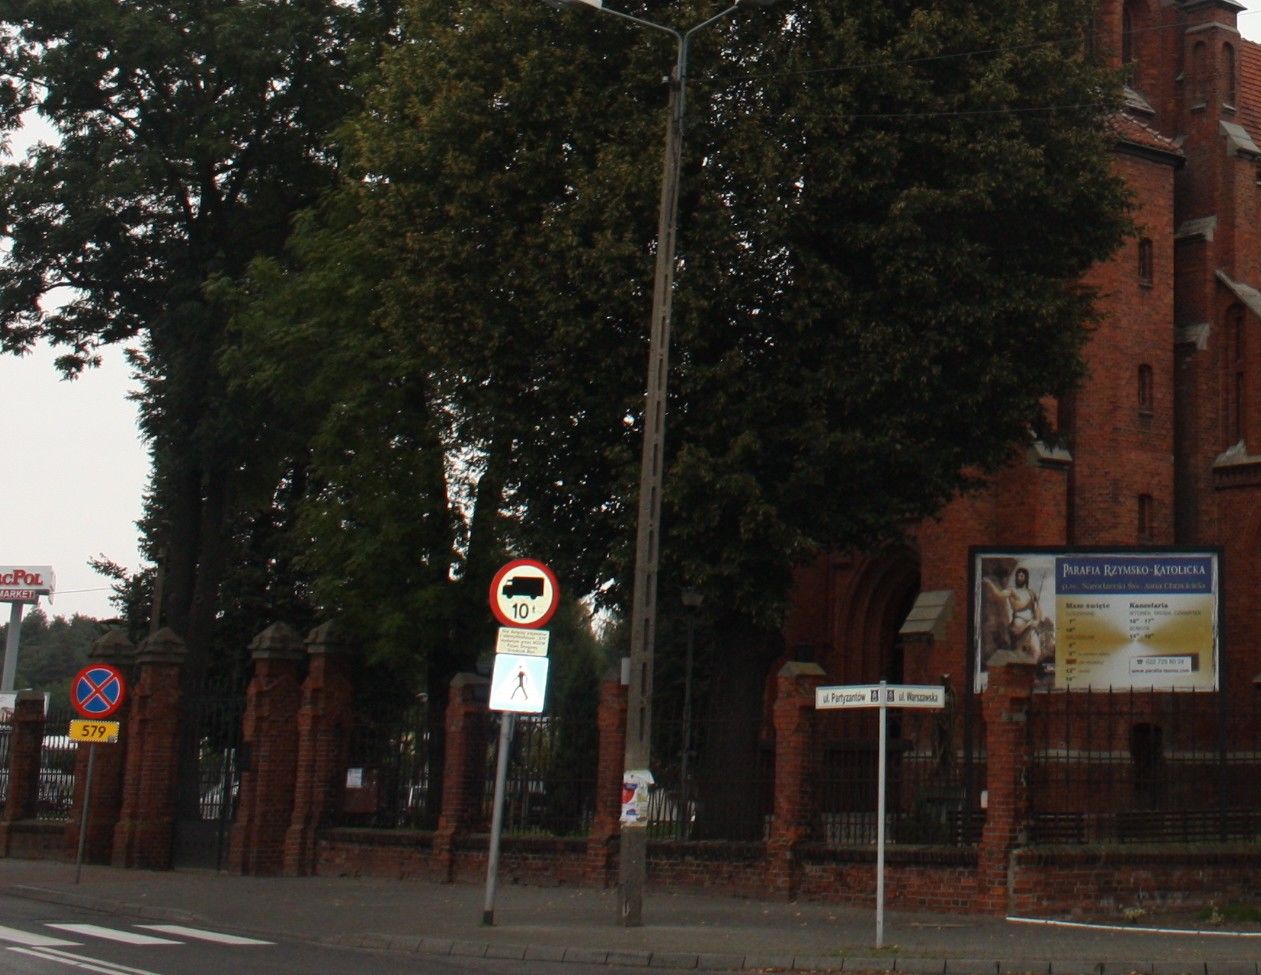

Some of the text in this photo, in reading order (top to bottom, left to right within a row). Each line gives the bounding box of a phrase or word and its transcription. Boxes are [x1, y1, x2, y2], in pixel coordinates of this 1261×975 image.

[512, 603, 529, 619] 10
[831, 692, 867, 705] Partyzantów
[898, 692, 938, 703] ul. Warszawska
[81, 725, 107, 738] 579
